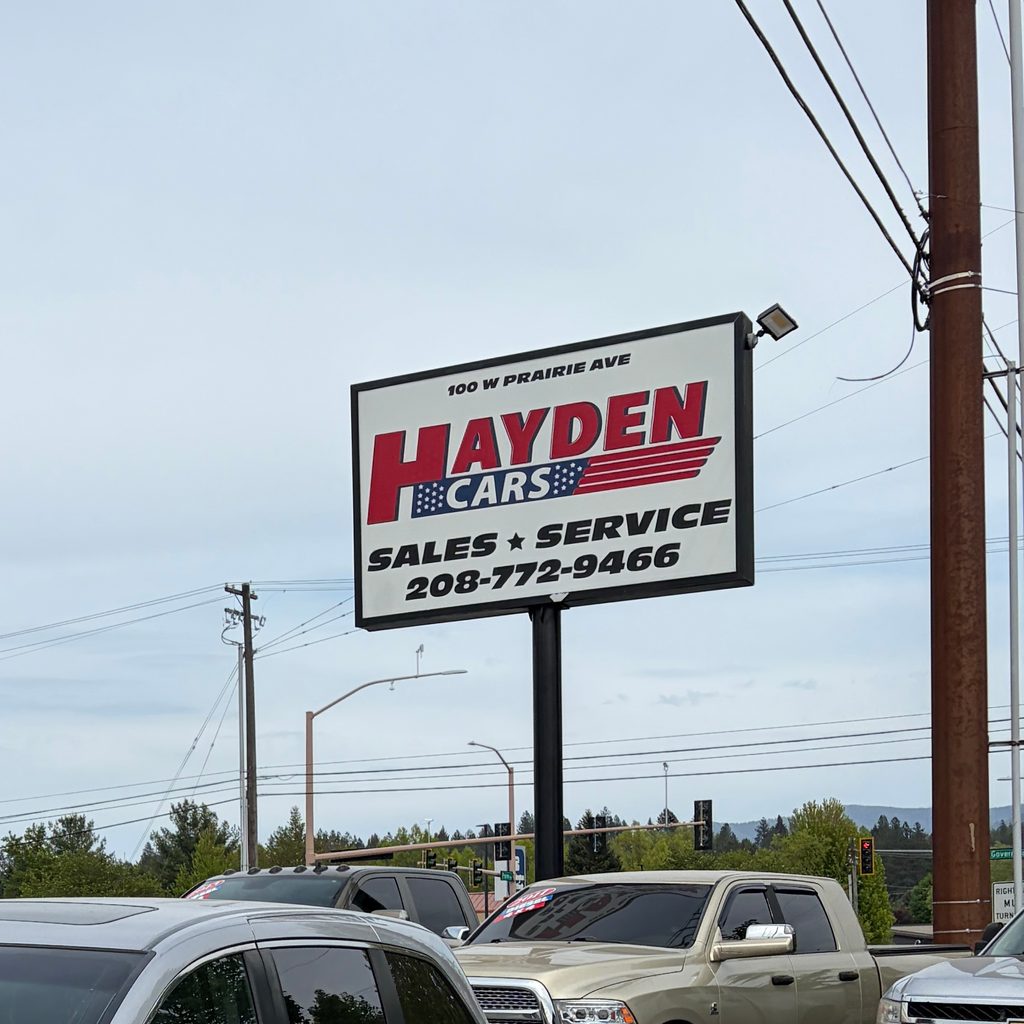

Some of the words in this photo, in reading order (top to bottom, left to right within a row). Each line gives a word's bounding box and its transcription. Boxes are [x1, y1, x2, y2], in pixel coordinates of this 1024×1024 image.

[448, 382, 479, 396] 100
[483, 377, 499, 390] W
[503, 362, 586, 387] PRAIRIE
[589, 353, 631, 372] AVE
[367, 380, 708, 525] HAYDEN
[446, 467, 552, 509] CARS
[367, 532, 498, 572] SALES
[535, 498, 733, 549] SERVICE
[405, 542, 681, 601] 208-772-9466
